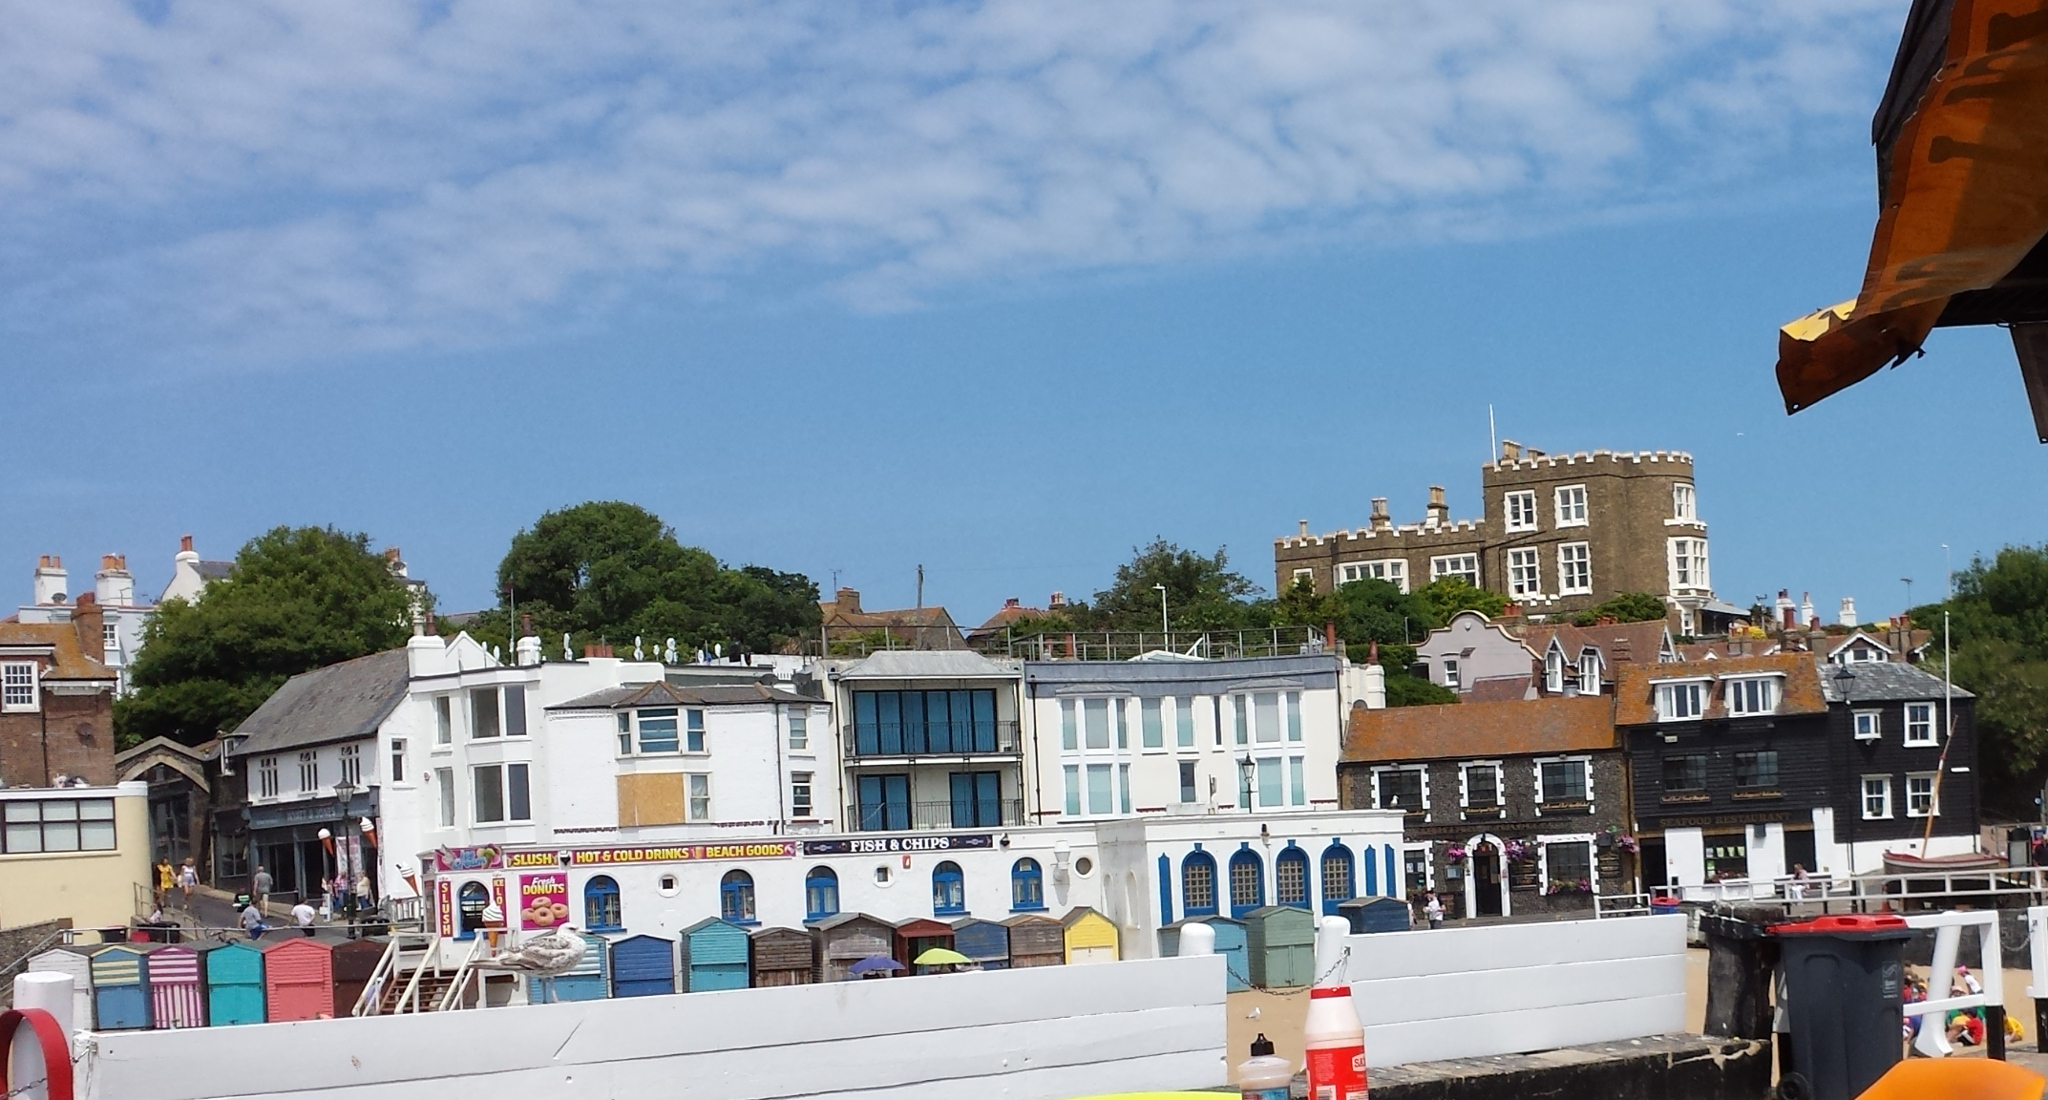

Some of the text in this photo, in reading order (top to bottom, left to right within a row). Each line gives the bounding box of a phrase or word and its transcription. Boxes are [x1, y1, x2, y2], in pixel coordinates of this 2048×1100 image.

[1660, 812, 1791, 827] SEAFOOD RESTAURANT
[706, 844, 784, 858] BEACH GOODS
[850, 837, 950, 852] FISH & CHIPS
[513, 853, 552, 867] SLUSH
[576, 847, 689, 863] HOT & COLD DRINKS
[532, 875, 556, 886] Fresh
[523, 883, 565, 895] DONUTS
[441, 882, 451, 935] SLUSH
